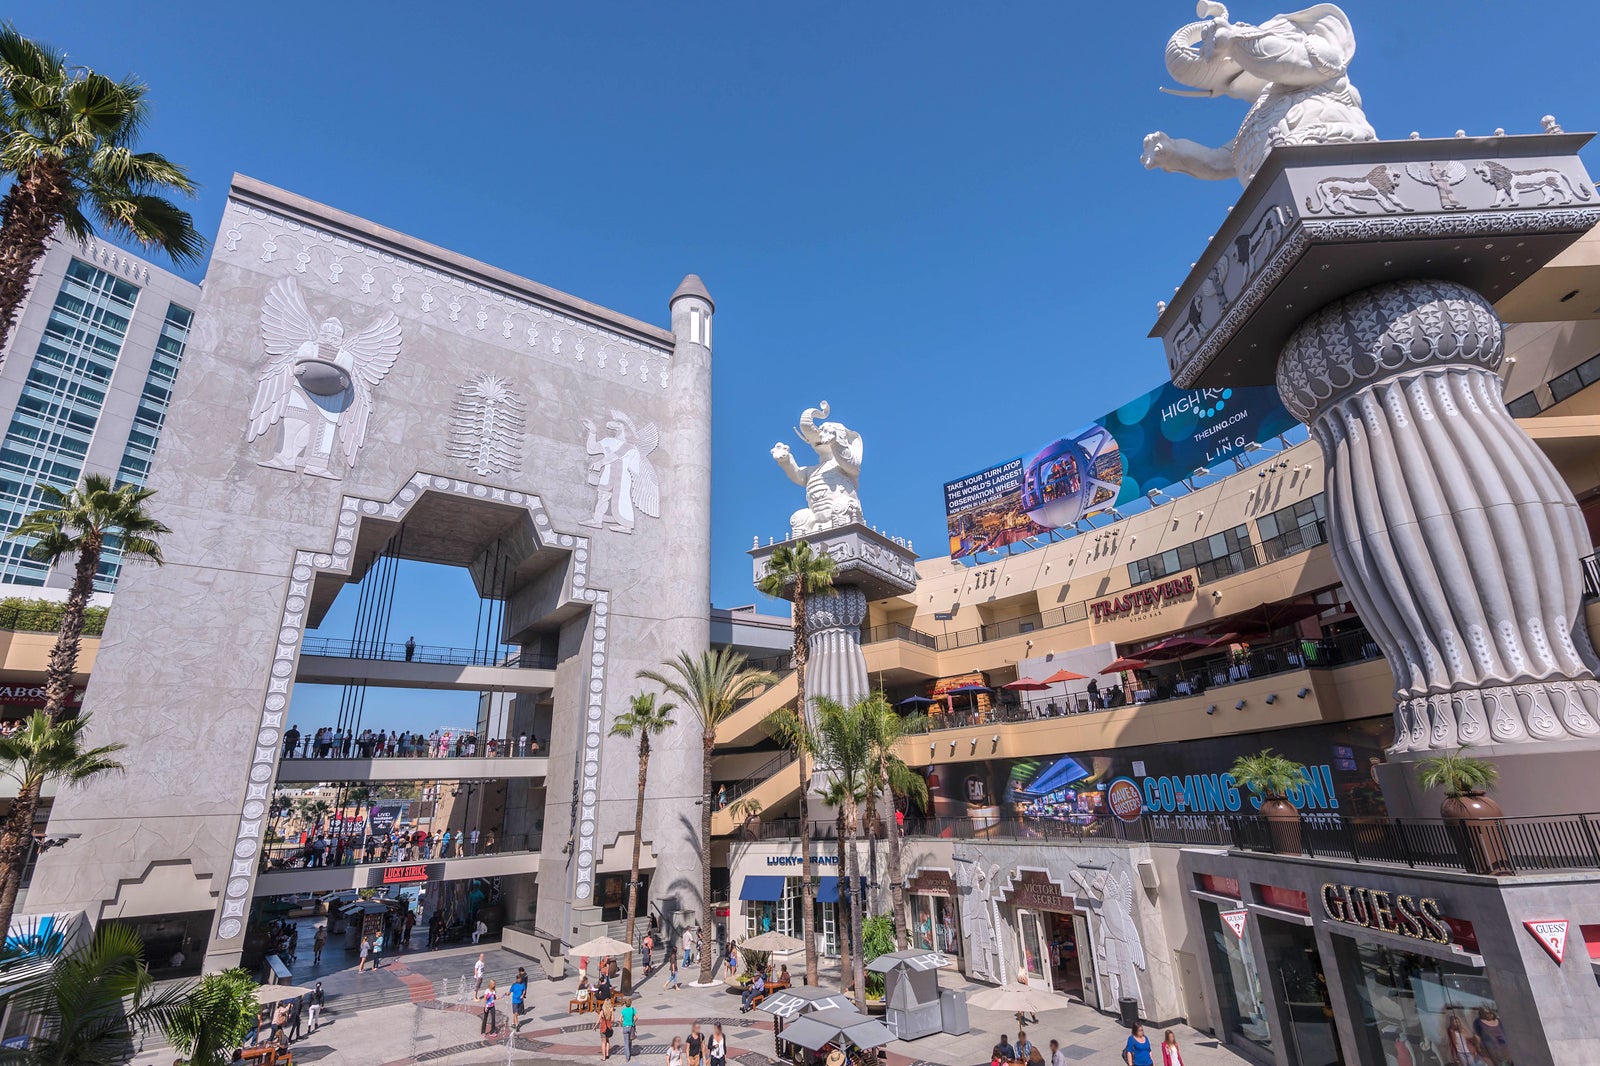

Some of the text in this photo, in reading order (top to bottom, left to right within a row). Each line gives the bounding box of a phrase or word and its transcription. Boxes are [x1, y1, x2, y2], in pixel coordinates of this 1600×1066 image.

[1161, 390, 1200, 422] HIGH
[1193, 409, 1249, 442] THELINQ.COM
[1205, 436, 1245, 462] LINQ
[947, 460, 1021, 492] TAKE YOUR TURN ATOP
[948, 468, 1023, 500] THE WORLD'S LARGEST
[949, 479, 1020, 508] OBSERVATION WHEEL
[987, 494, 1003, 502] VEGAS
[1090, 575, 1195, 618] TRASTEVERE
[1130, 615, 1147, 623] VINO
[968, 780, 984, 796] EAT
[1111, 786, 1139, 804] DAVE &
[1143, 765, 1339, 812] COMING SON!
[1152, 815, 1170, 829] EAT
[1175, 815, 1211, 830] DRINK
[384, 864, 428, 879] LUCKY STRIKE
[767, 856, 839, 866] LUCKY RAND
[1032, 894, 1062, 905] SECRET
[1320, 882, 1450, 945] GUESS
[1535, 923, 1566, 934] GUESS
